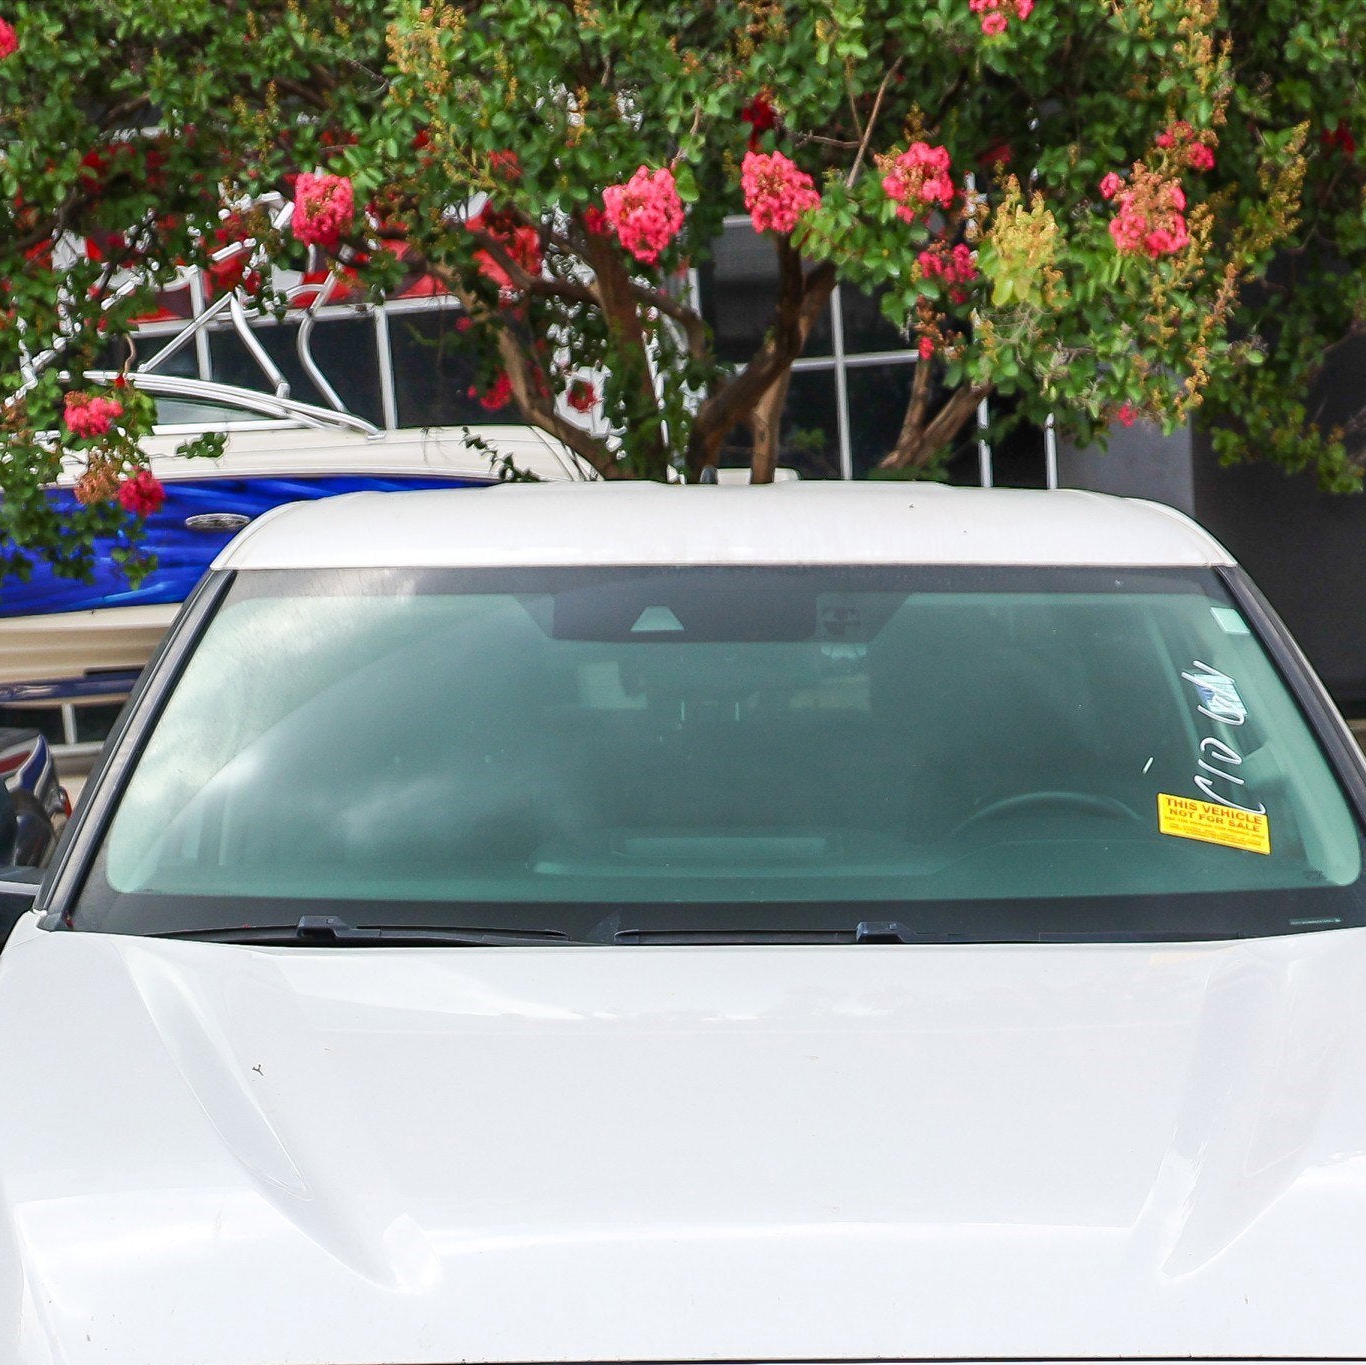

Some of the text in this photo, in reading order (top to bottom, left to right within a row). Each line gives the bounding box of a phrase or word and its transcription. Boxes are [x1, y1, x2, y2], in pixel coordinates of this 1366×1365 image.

[1165, 798, 1263, 825] THIS VEHICLE
[1169, 809, 1261, 833] NOT FOR SALE
